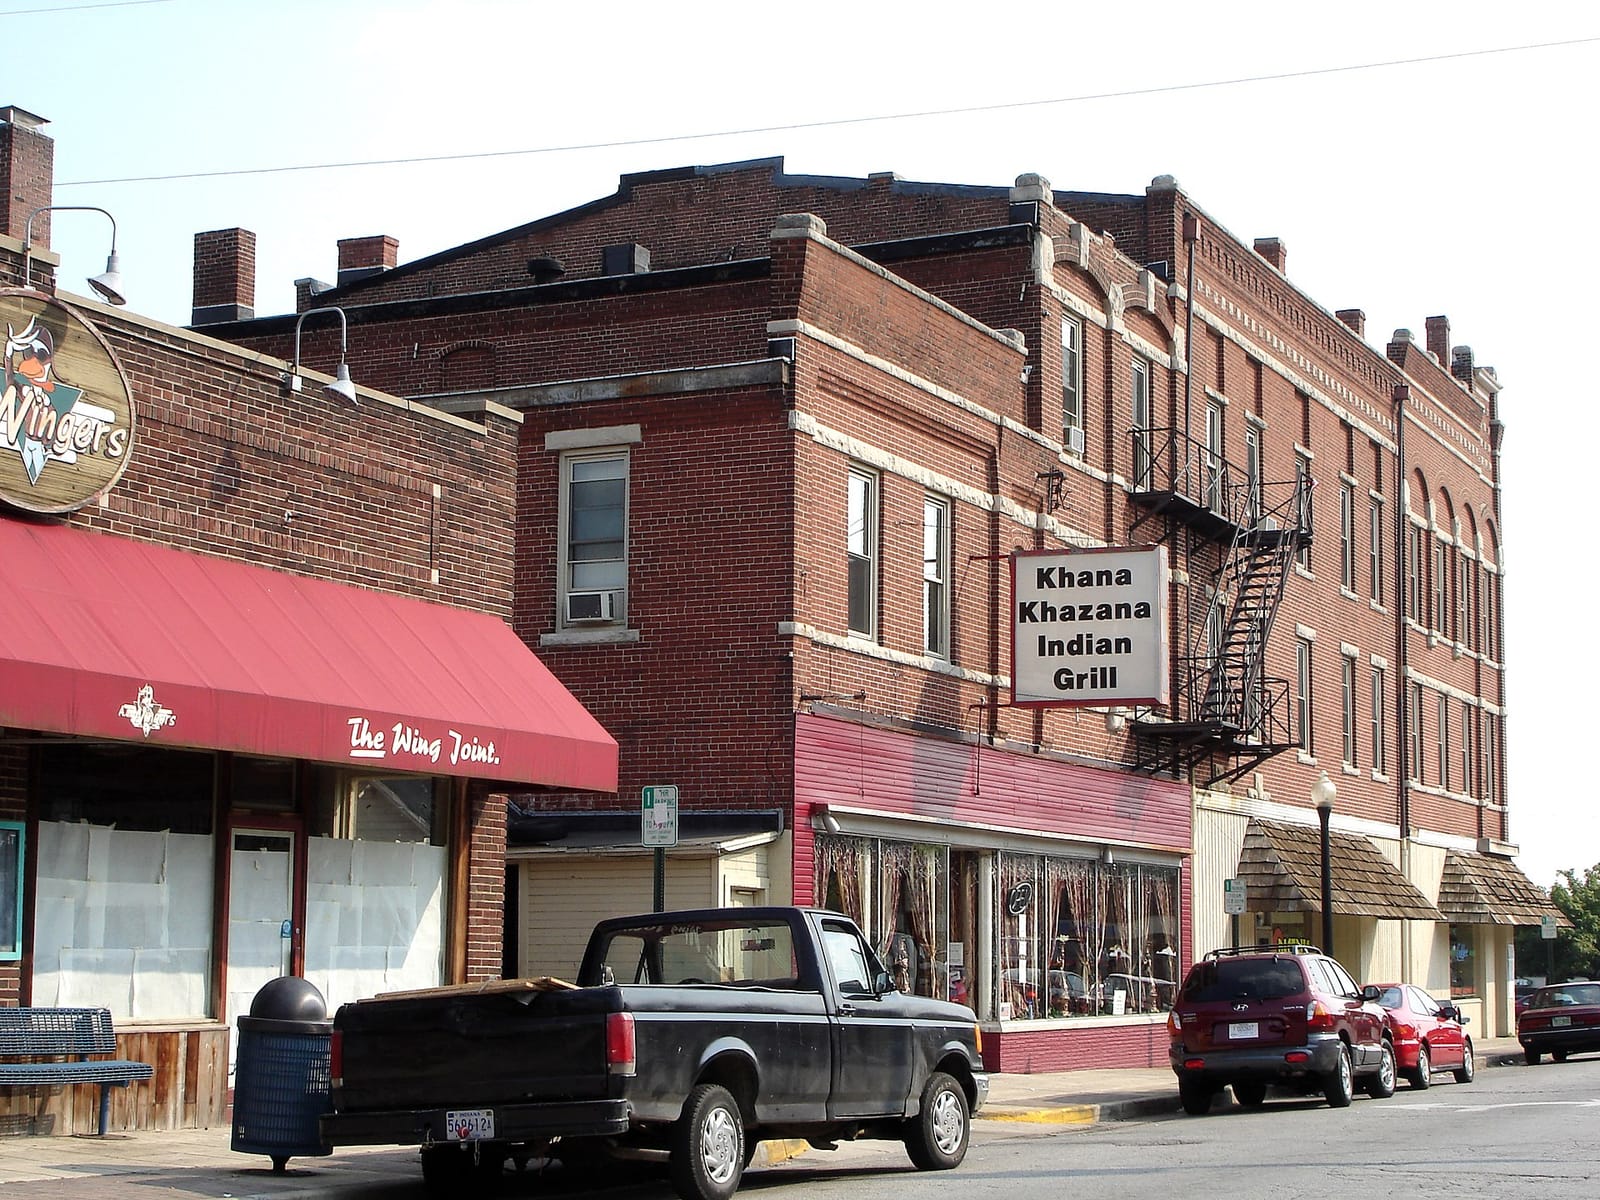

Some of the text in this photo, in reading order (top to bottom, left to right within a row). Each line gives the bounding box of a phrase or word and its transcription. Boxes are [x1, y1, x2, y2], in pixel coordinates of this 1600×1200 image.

[1036, 567, 1132, 589] Khana
[1018, 601, 1151, 624] Khazana
[1037, 634, 1132, 657] Indian
[1053, 666, 1117, 690] Grill
[347, 717, 501, 765] The Wing Joint.
